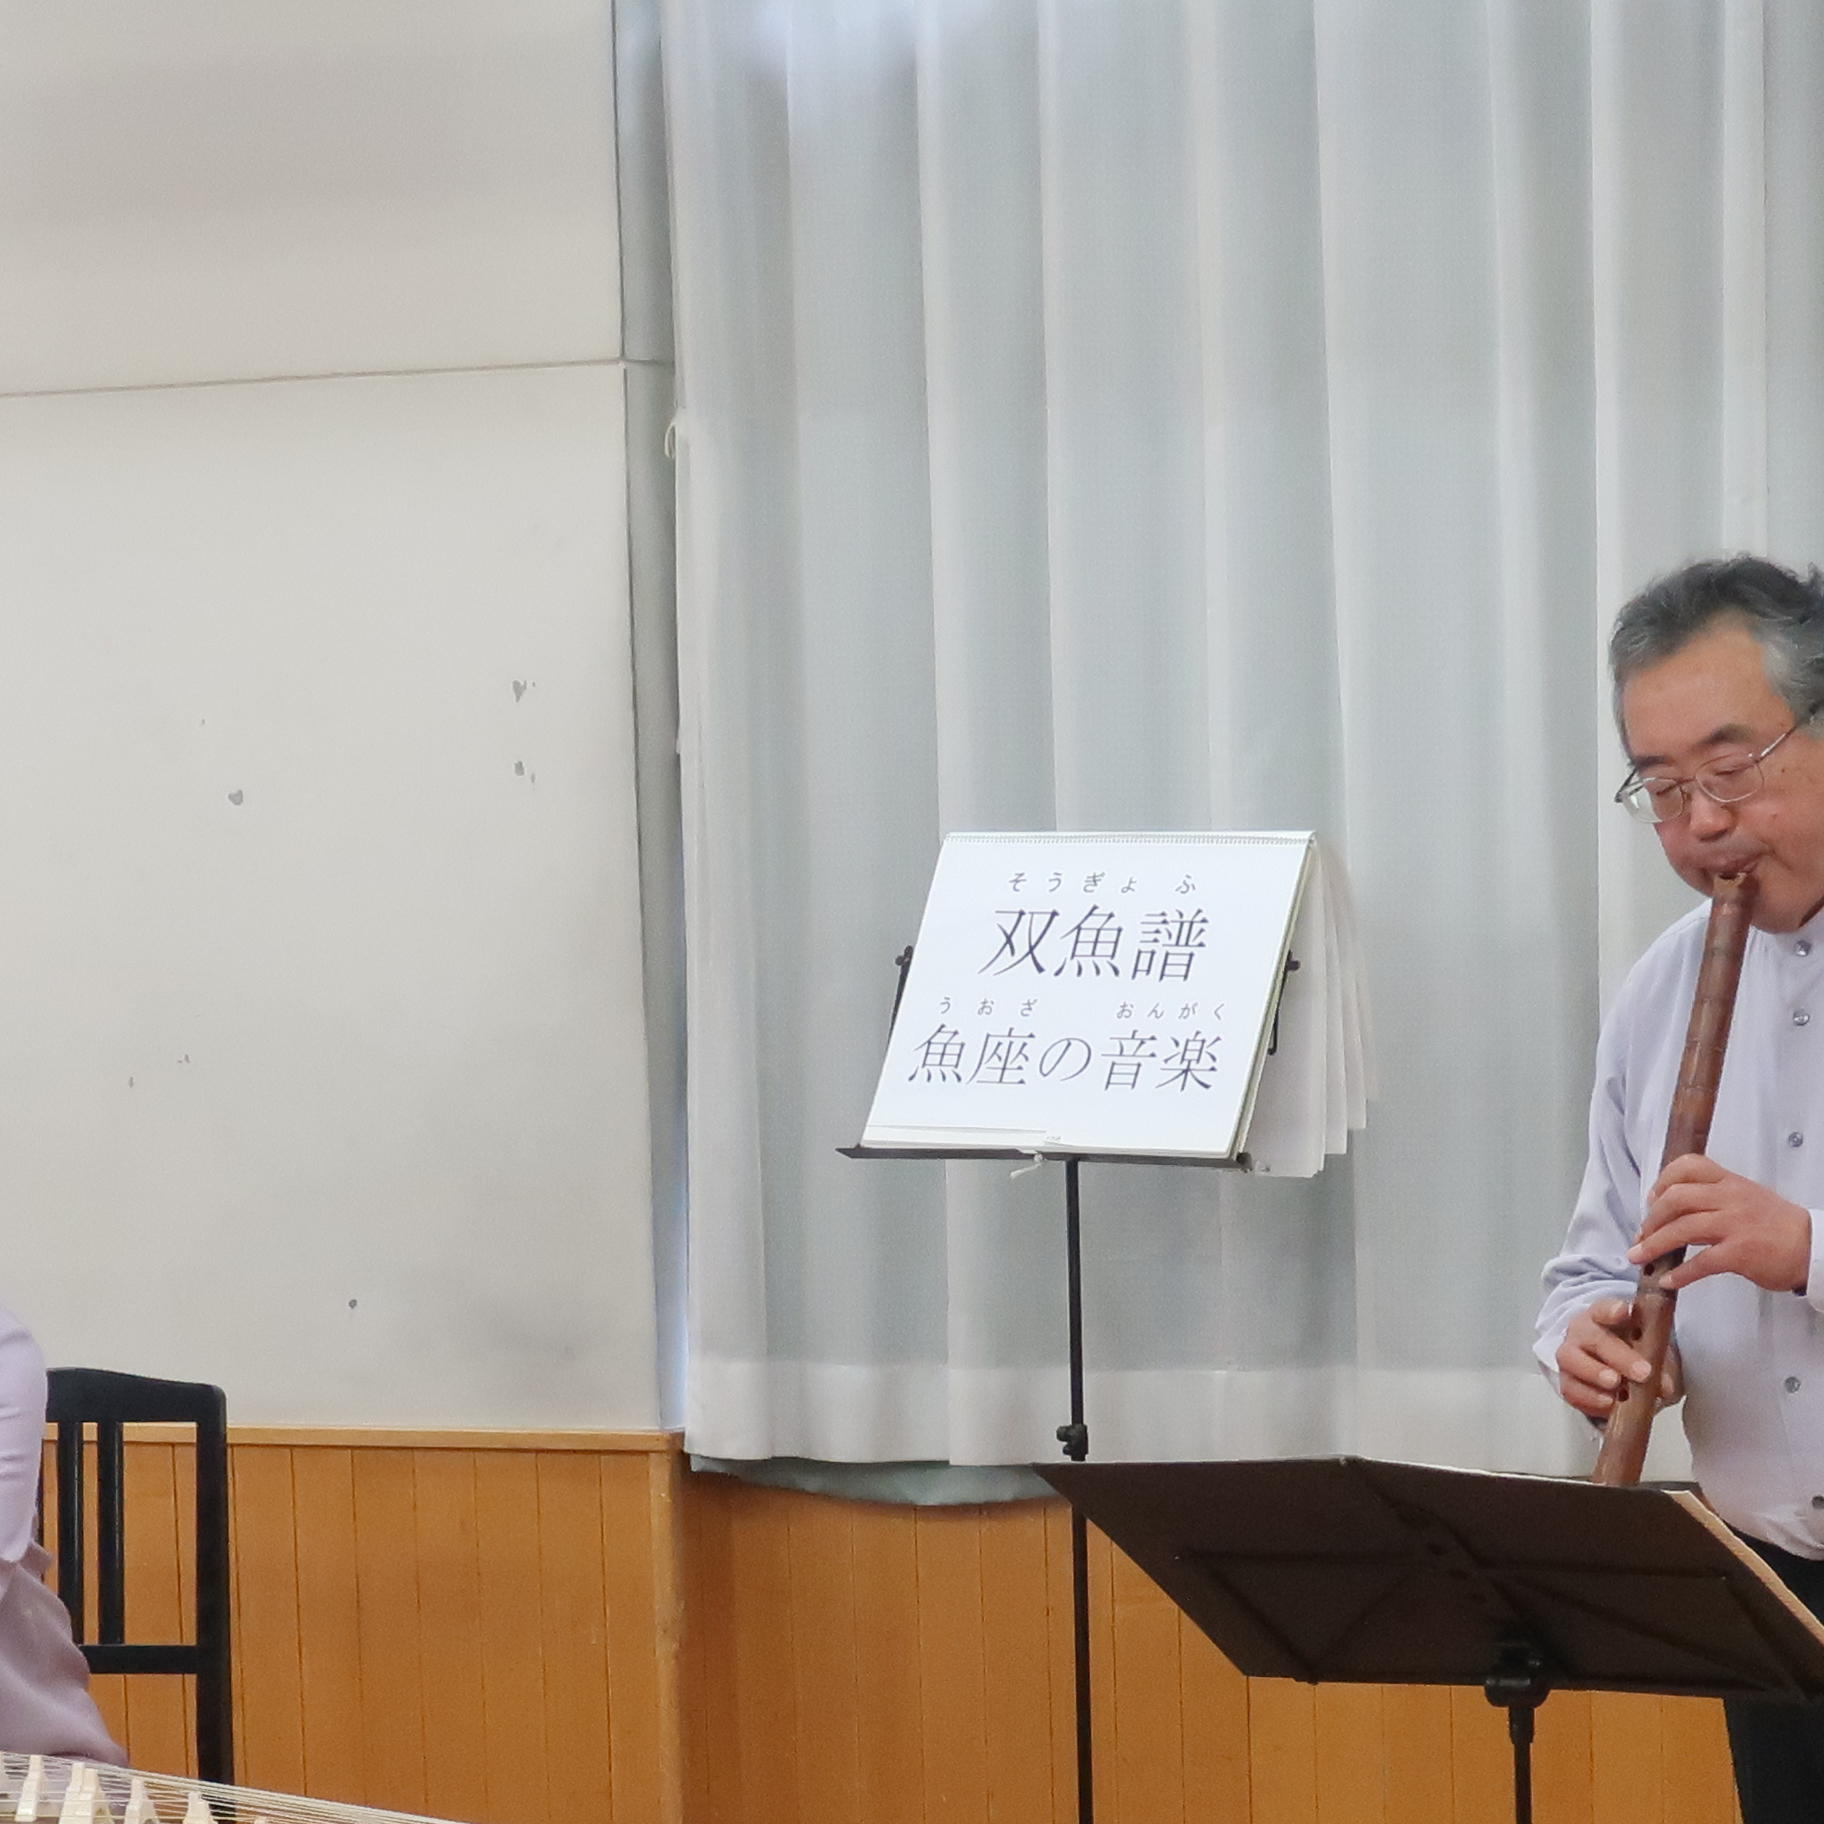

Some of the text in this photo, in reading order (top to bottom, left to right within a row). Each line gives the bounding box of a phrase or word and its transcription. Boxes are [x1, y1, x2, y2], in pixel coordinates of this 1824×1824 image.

[977, 903, 1210, 983] 双魚譜
[907, 1023, 1223, 1093] 魚座の音楽
